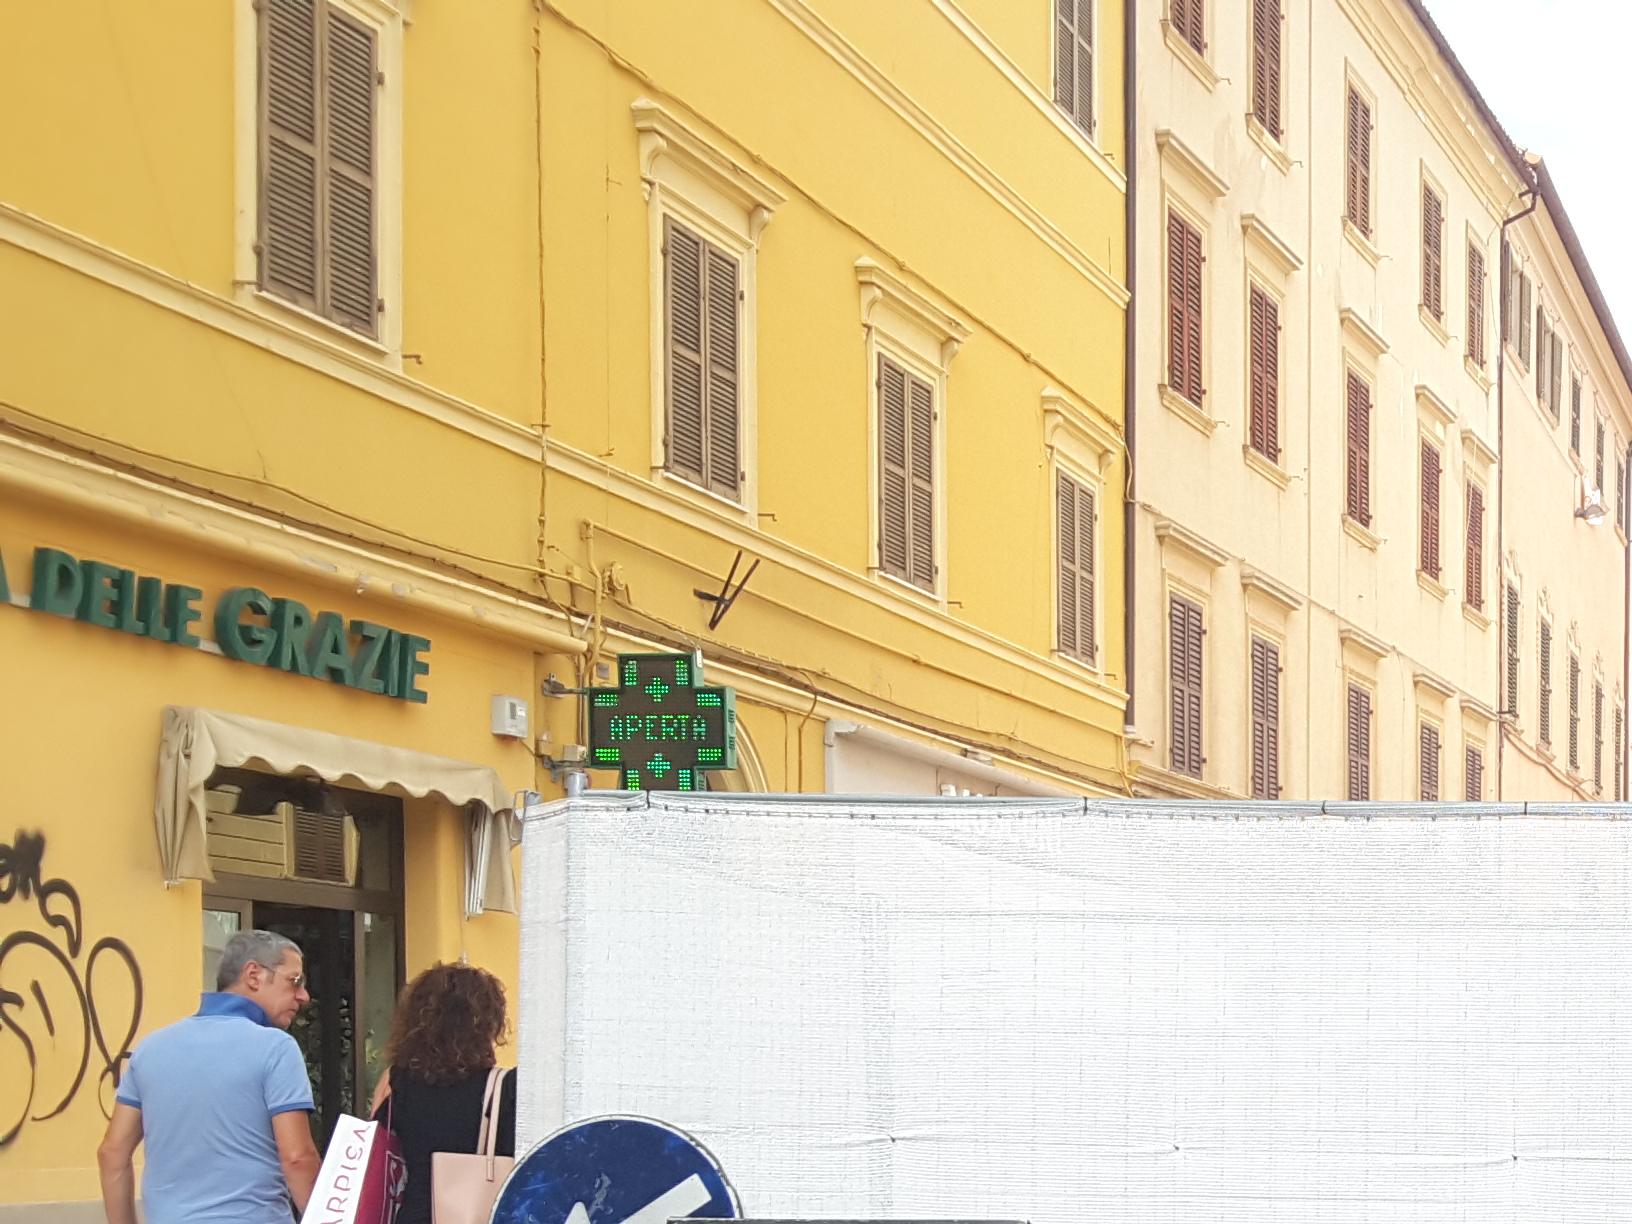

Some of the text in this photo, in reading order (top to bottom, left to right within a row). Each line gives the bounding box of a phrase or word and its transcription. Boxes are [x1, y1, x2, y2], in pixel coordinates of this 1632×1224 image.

[29, 546, 203, 648] DELLE
[214, 587, 431, 704] GRAZIE
[610, 714, 707, 740] APERTA
